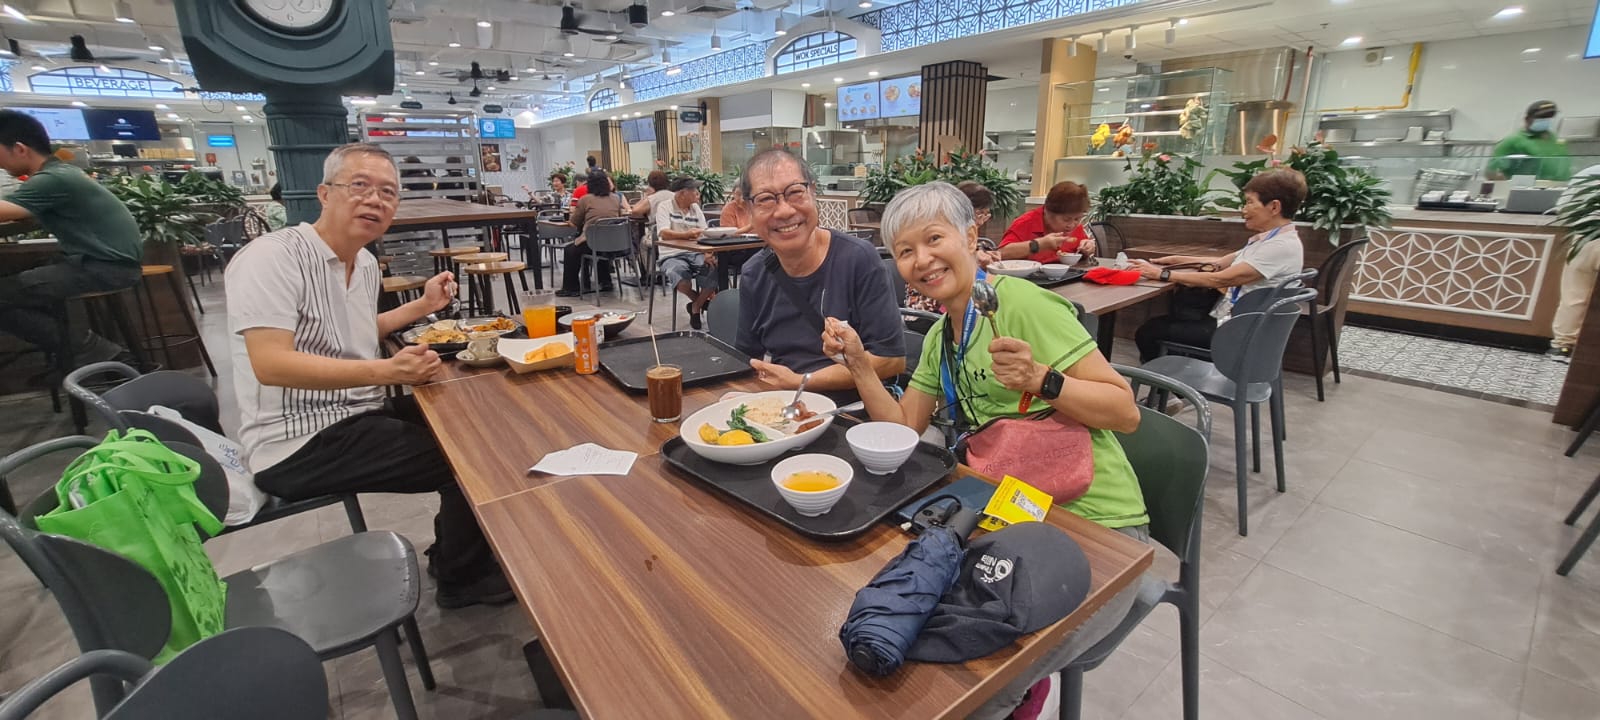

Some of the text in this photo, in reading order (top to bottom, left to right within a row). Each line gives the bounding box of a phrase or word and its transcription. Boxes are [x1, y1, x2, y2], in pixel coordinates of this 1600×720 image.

[287, 13, 294, 21] 6
[796, 45, 837, 61] WOK SPECIALS
[75, 77, 145, 90] BEVERAGE
